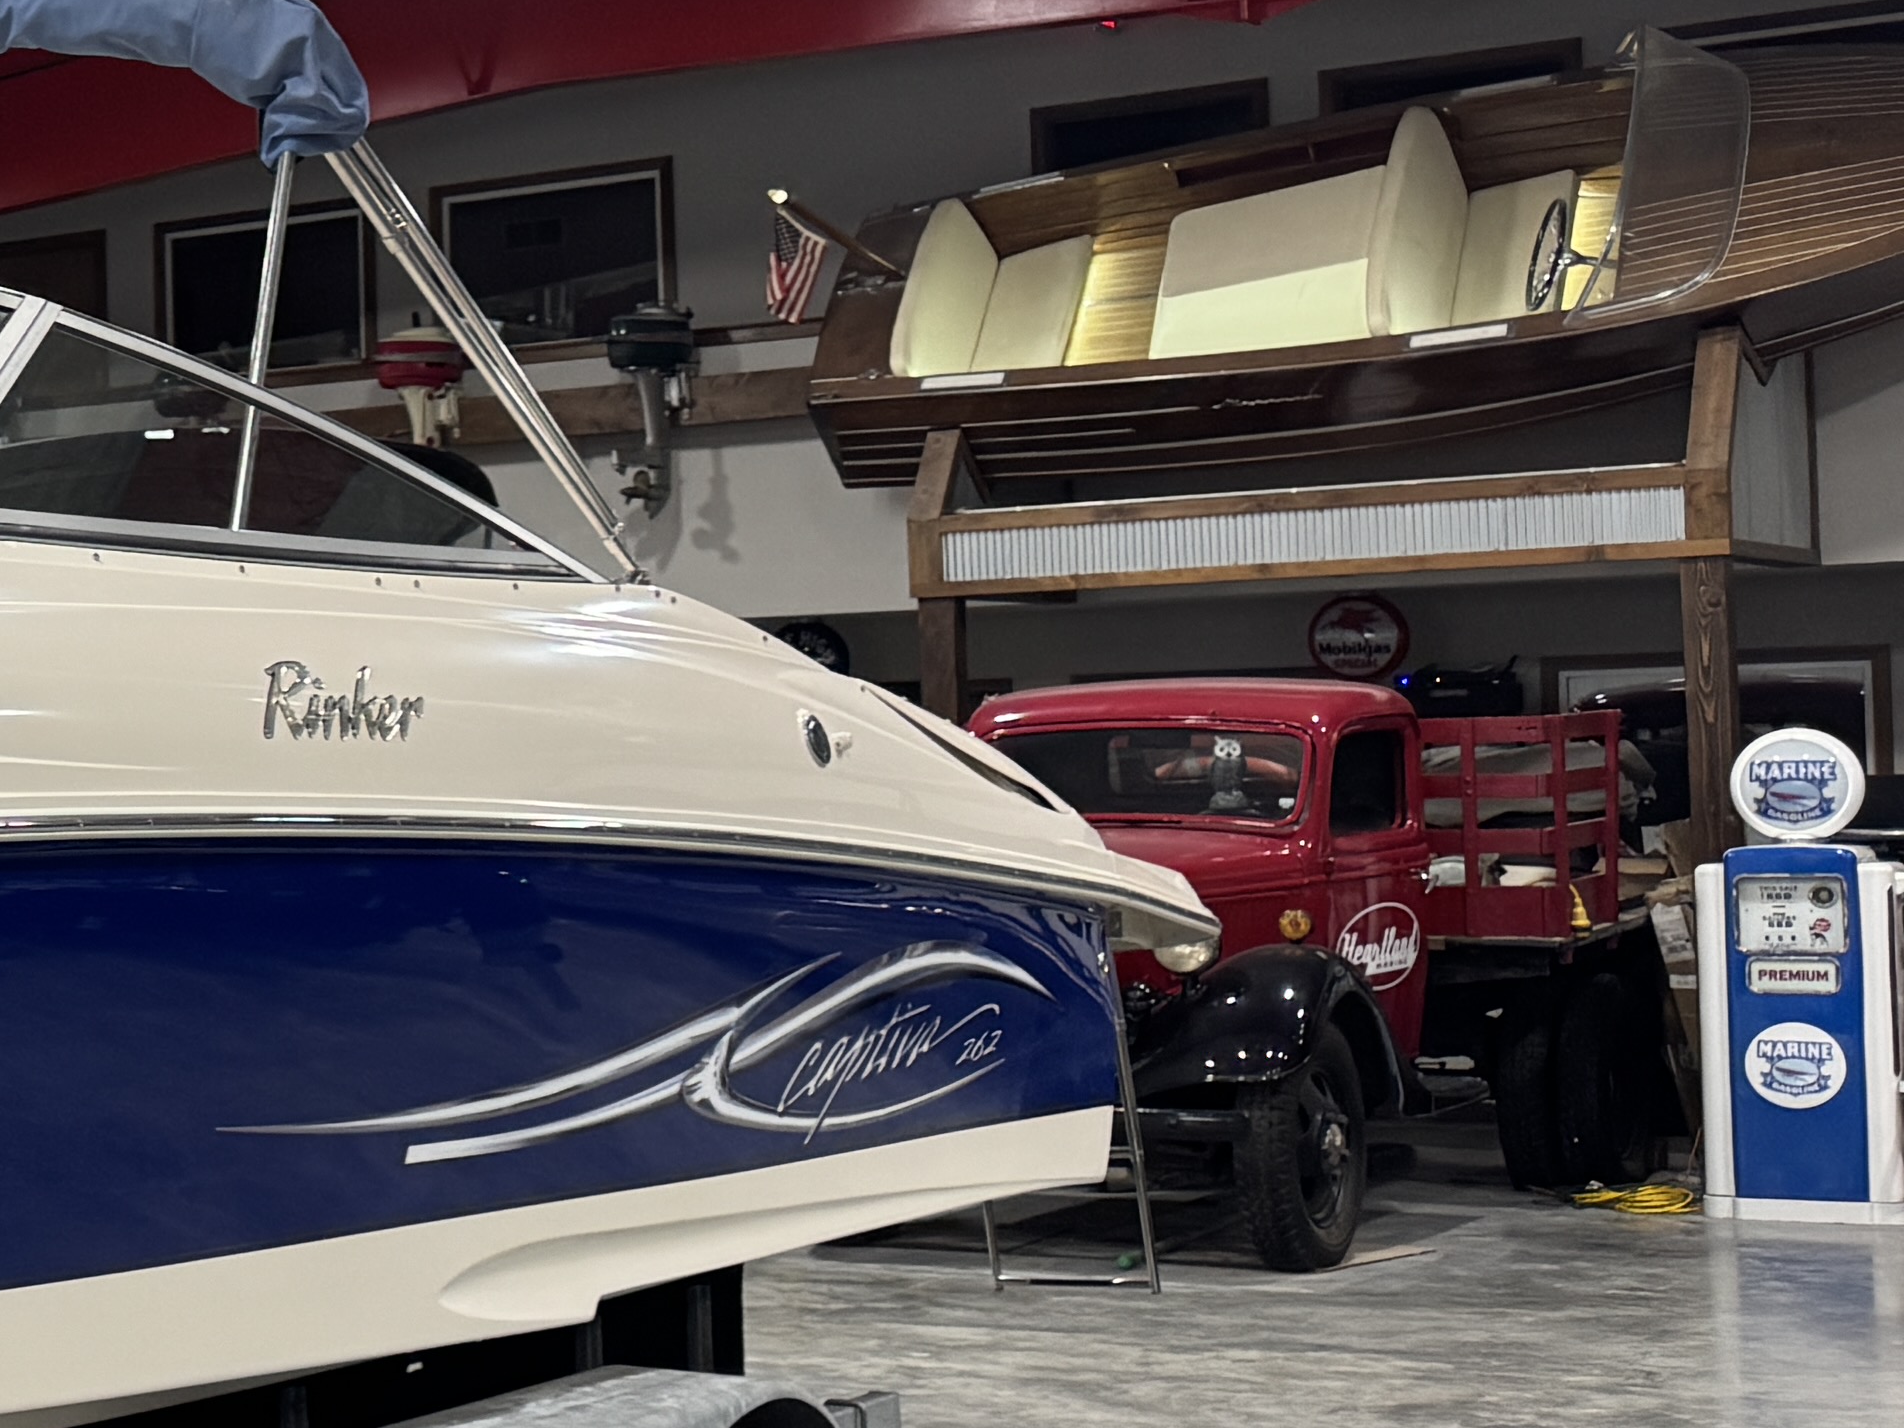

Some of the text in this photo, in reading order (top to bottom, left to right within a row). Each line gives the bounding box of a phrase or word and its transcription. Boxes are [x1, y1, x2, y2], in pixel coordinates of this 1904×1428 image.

[263, 660, 424, 742] Rinker
[1750, 759, 1837, 782] MARINE
[1767, 808, 1823, 821] GASOLINE
[1758, 969, 1829, 982] PREMIUM
[955, 1029, 1003, 1066] 262
[1757, 1039, 1833, 1061] MARINE
